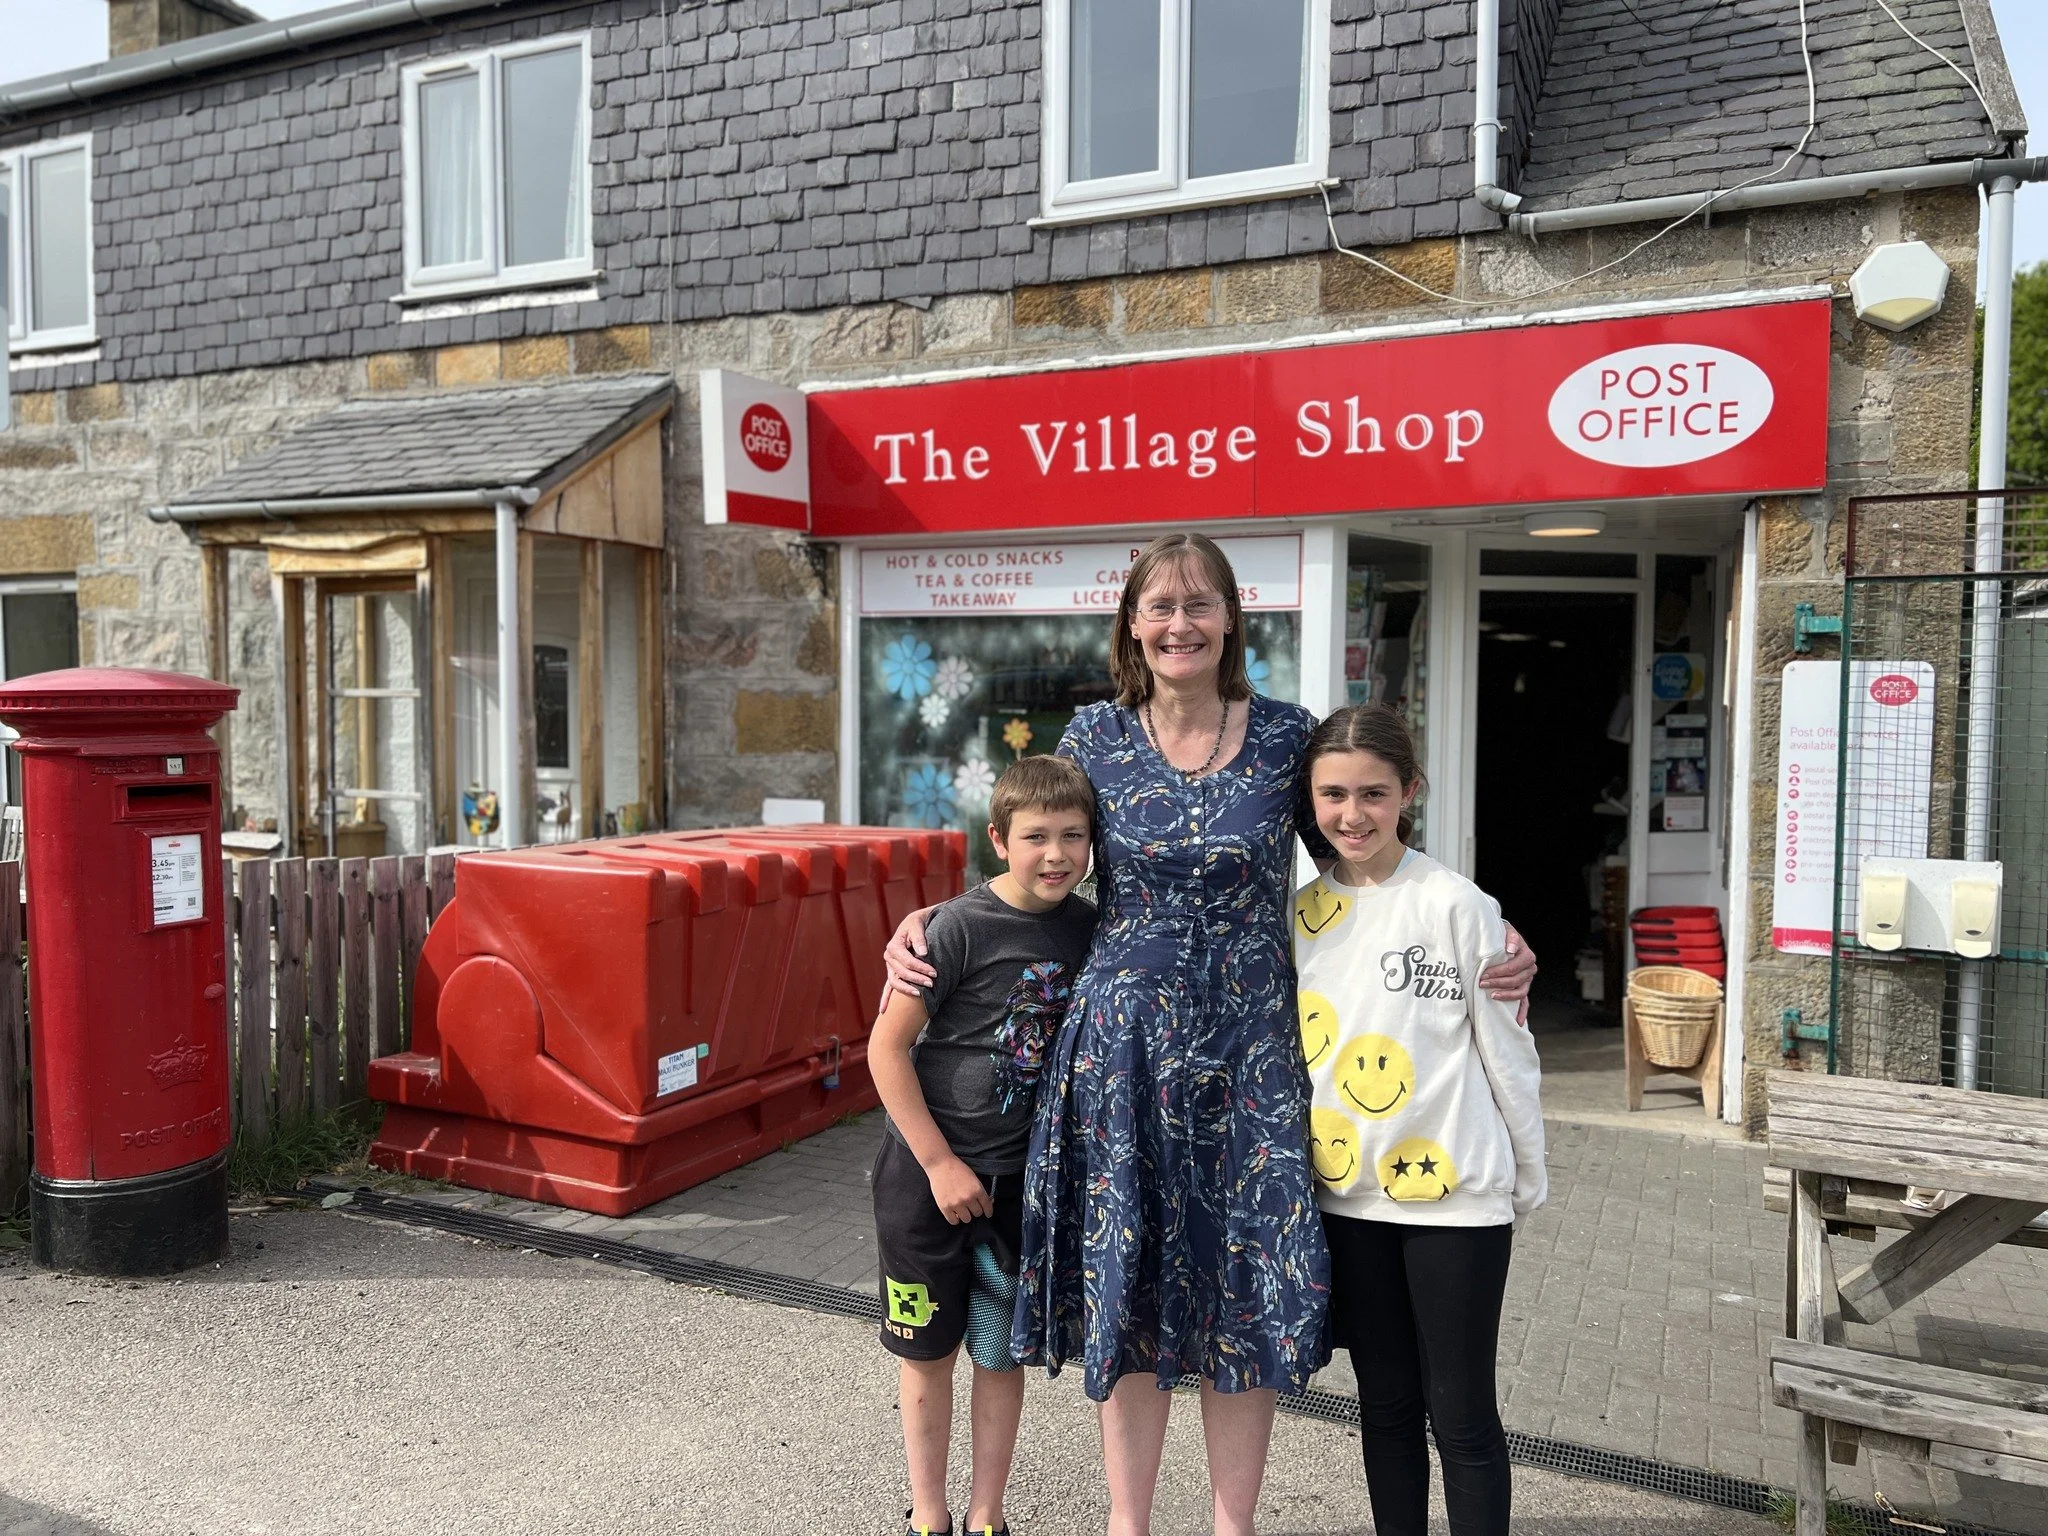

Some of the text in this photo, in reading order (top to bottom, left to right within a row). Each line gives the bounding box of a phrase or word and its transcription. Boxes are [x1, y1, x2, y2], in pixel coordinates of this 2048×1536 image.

[1601, 361, 1717, 401] POST
[751, 415, 782, 438] POST
[1578, 401, 1739, 442] OFFICE
[745, 433, 787, 459] OFFICE
[874, 395, 1484, 485] The Village Shop
[886, 550, 1064, 569] HOT & COLD SNACKS
[915, 572, 1033, 588] TEA & COFFEE
[1096, 569, 1129, 584] CAR
[930, 592, 1017, 607] TAKEAWAY
[1074, 589, 1122, 604] LICEN
[1881, 680, 1909, 690] POST
[1874, 689, 1912, 699] OFFICE
[1790, 727, 1813, 738] Post
[1817, 727, 1839, 738] Offi
[1790, 740, 1837, 751] available
[120, 1124, 175, 1151] POST
